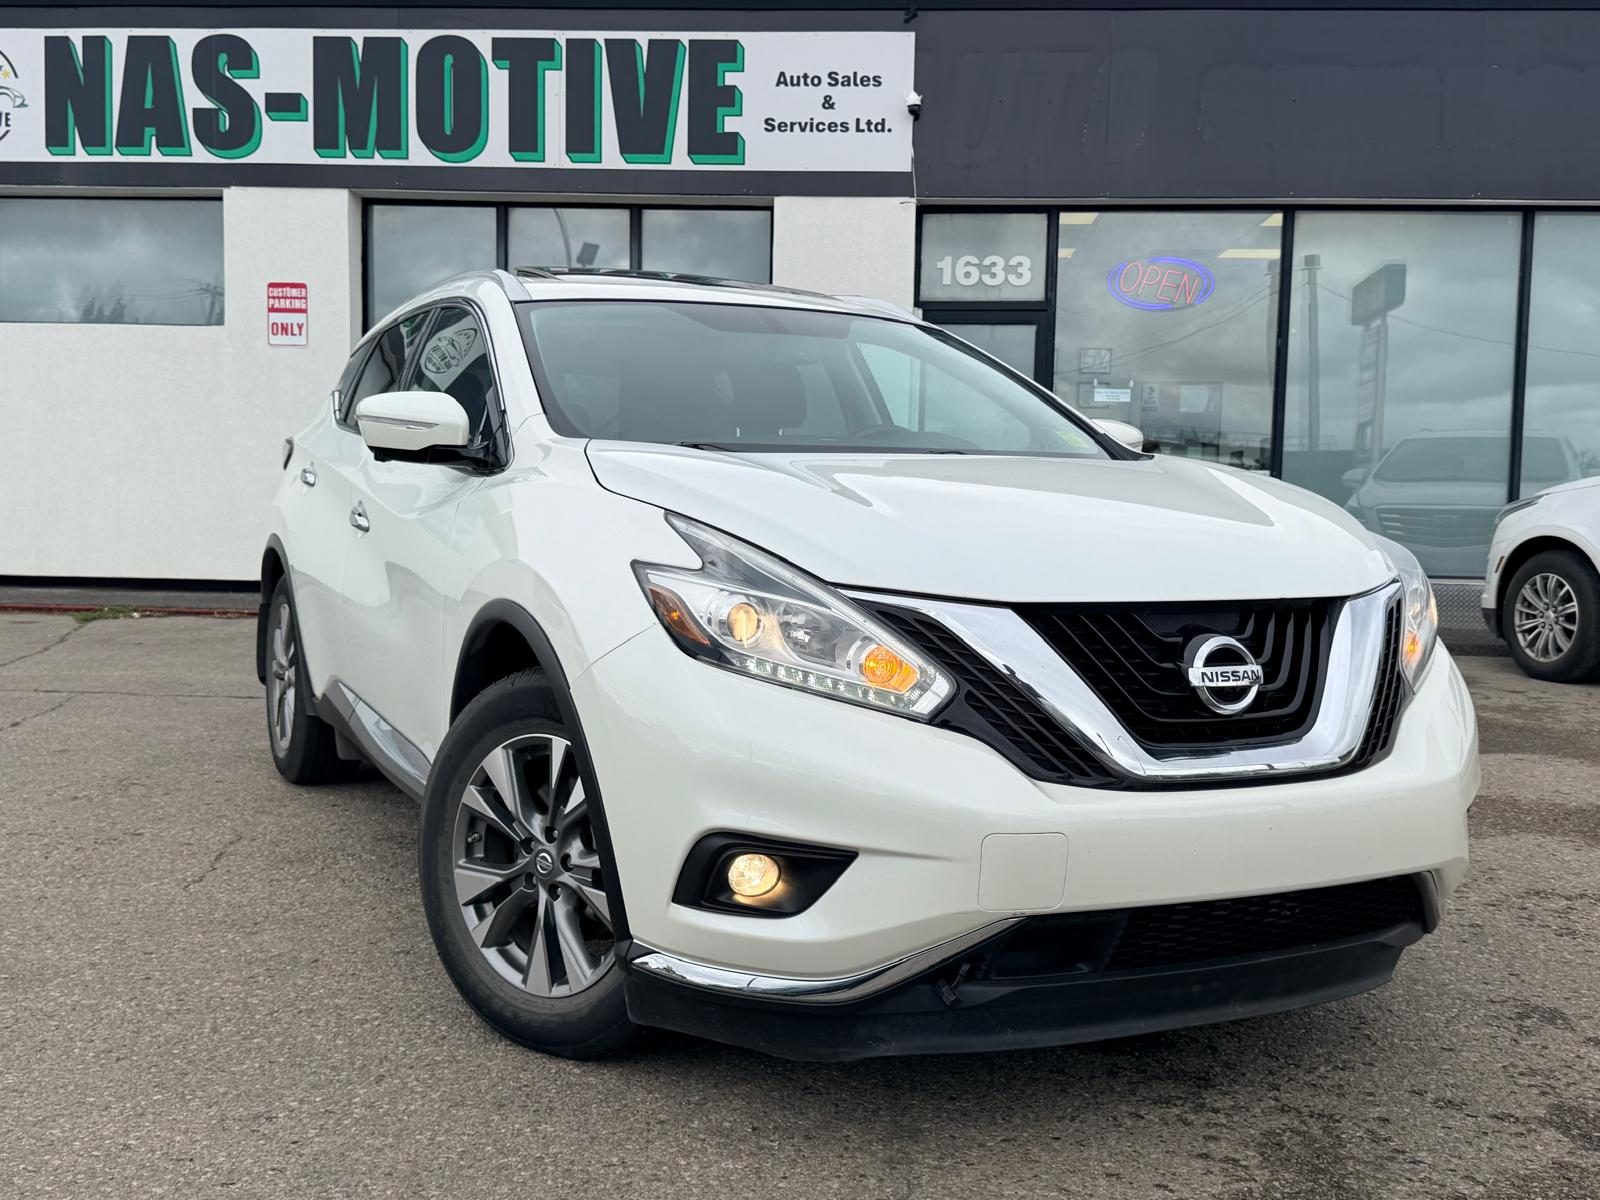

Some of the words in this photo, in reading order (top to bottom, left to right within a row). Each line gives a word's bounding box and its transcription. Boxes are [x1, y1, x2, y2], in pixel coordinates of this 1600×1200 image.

[775, 71, 822, 88] Auto
[826, 71, 883, 88] Sales
[44, 33, 746, 165] NAS-MOTIVE
[821, 95, 836, 111] &
[763, 117, 850, 134] Services
[855, 117, 893, 134] Ltd.
[936, 255, 1032, 286] 1633
[1119, 262, 1202, 305] OPEN
[268, 287, 306, 297] CUSTOMER
[268, 298, 306, 309] PARKING
[271, 322, 304, 336] ONLY
[1201, 669, 1259, 682] NISSAN
